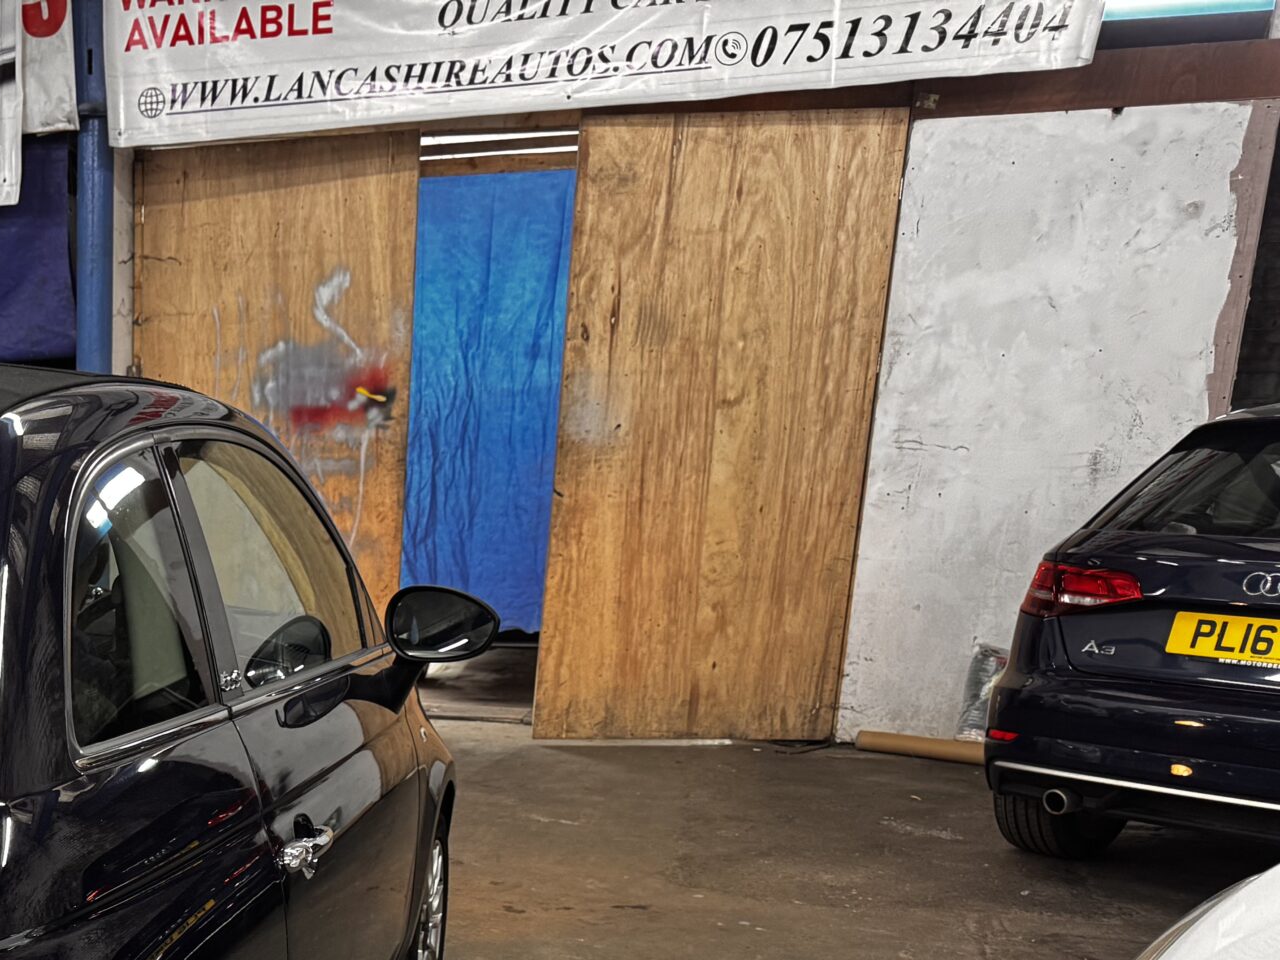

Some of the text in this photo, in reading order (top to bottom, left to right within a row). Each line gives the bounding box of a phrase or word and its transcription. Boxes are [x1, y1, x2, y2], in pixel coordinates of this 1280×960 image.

[124, 0, 334, 52] AVAILABLE
[750, 2, 1072, 67] 07513134404
[168, 35, 717, 111] WWW.LANCASHIREAUTOS.COM
[1081, 639, 1116, 656] A3
[1189, 618, 1278, 656] PL16
